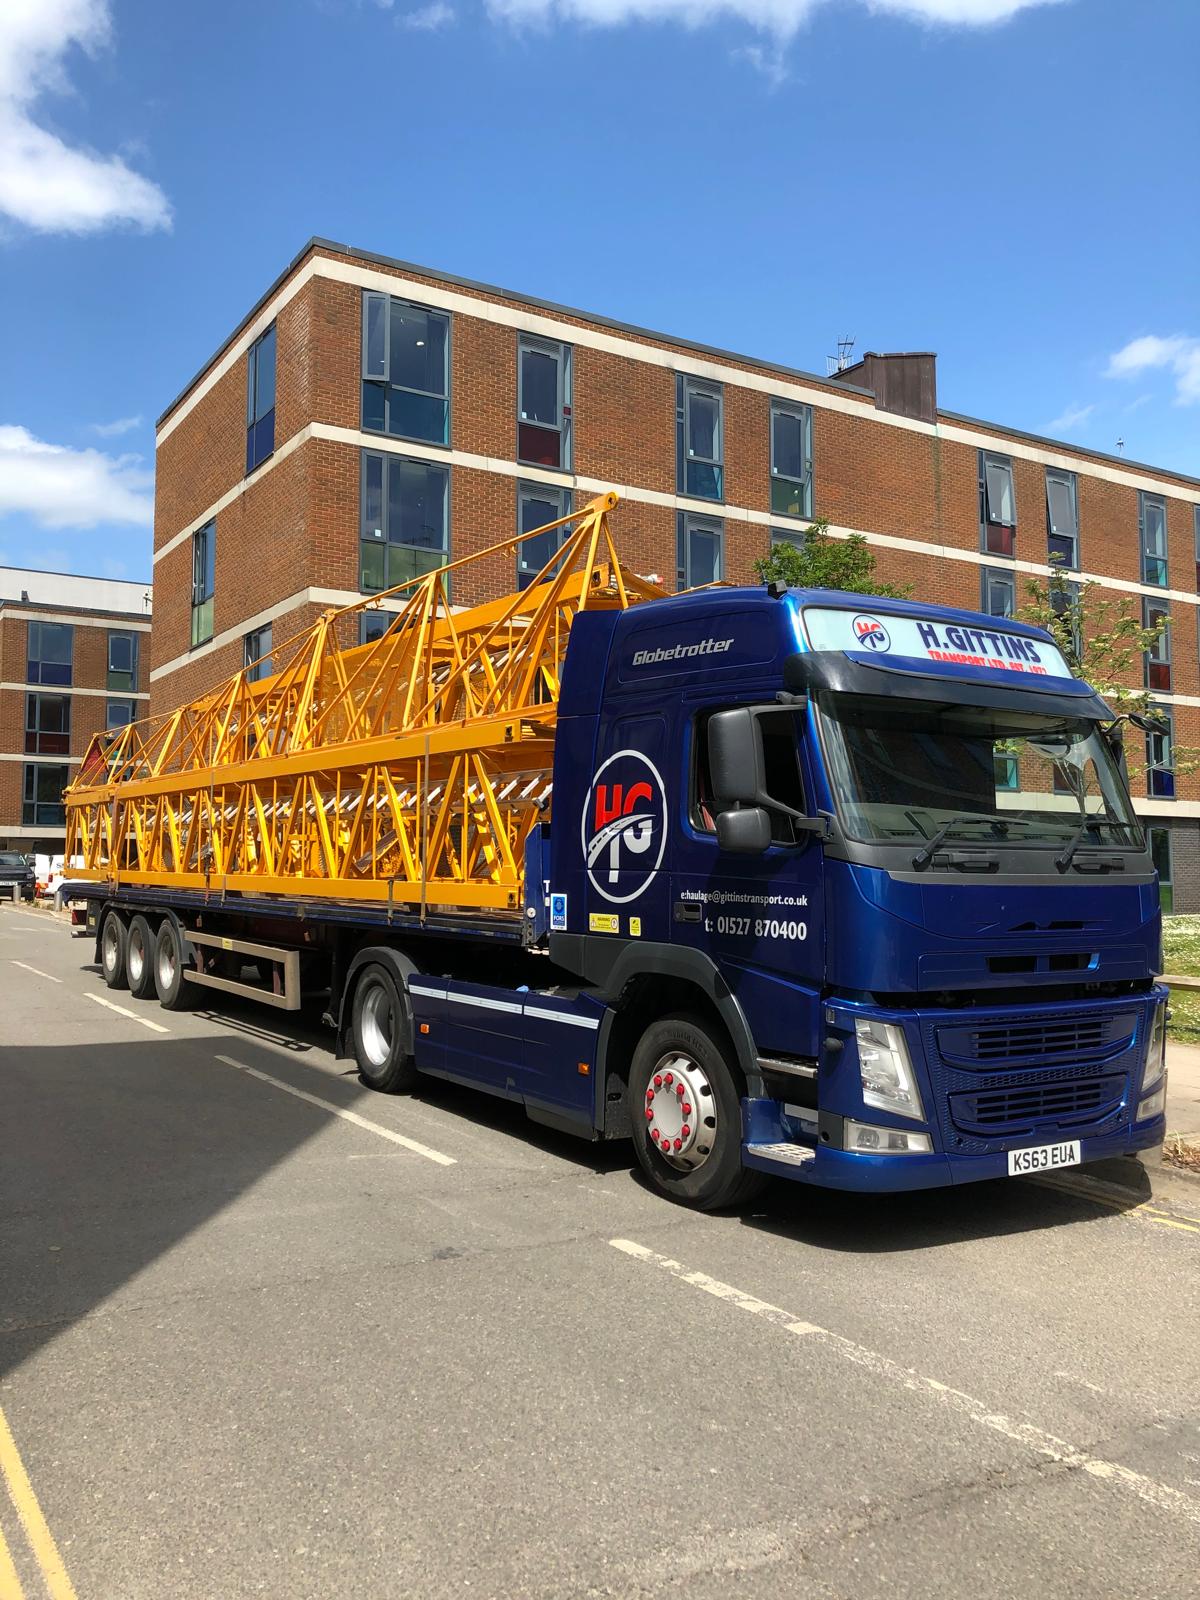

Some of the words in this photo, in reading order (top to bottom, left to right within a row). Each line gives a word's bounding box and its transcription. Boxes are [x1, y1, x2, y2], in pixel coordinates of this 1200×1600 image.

[632, 638, 735, 666] Globetrotter
[916, 622, 1041, 663] H.GITTINS
[927, 649, 986, 666] TRANSPORT
[680, 889, 808, 906] e:haulage@gittinstransport.co.uk
[704, 918, 714, 932] t:
[717, 916, 751, 935] 01527
[754, 919, 807, 940] 870400
[1013, 1149, 1048, 1172] KS63
[1051, 1144, 1075, 1165] EUA
